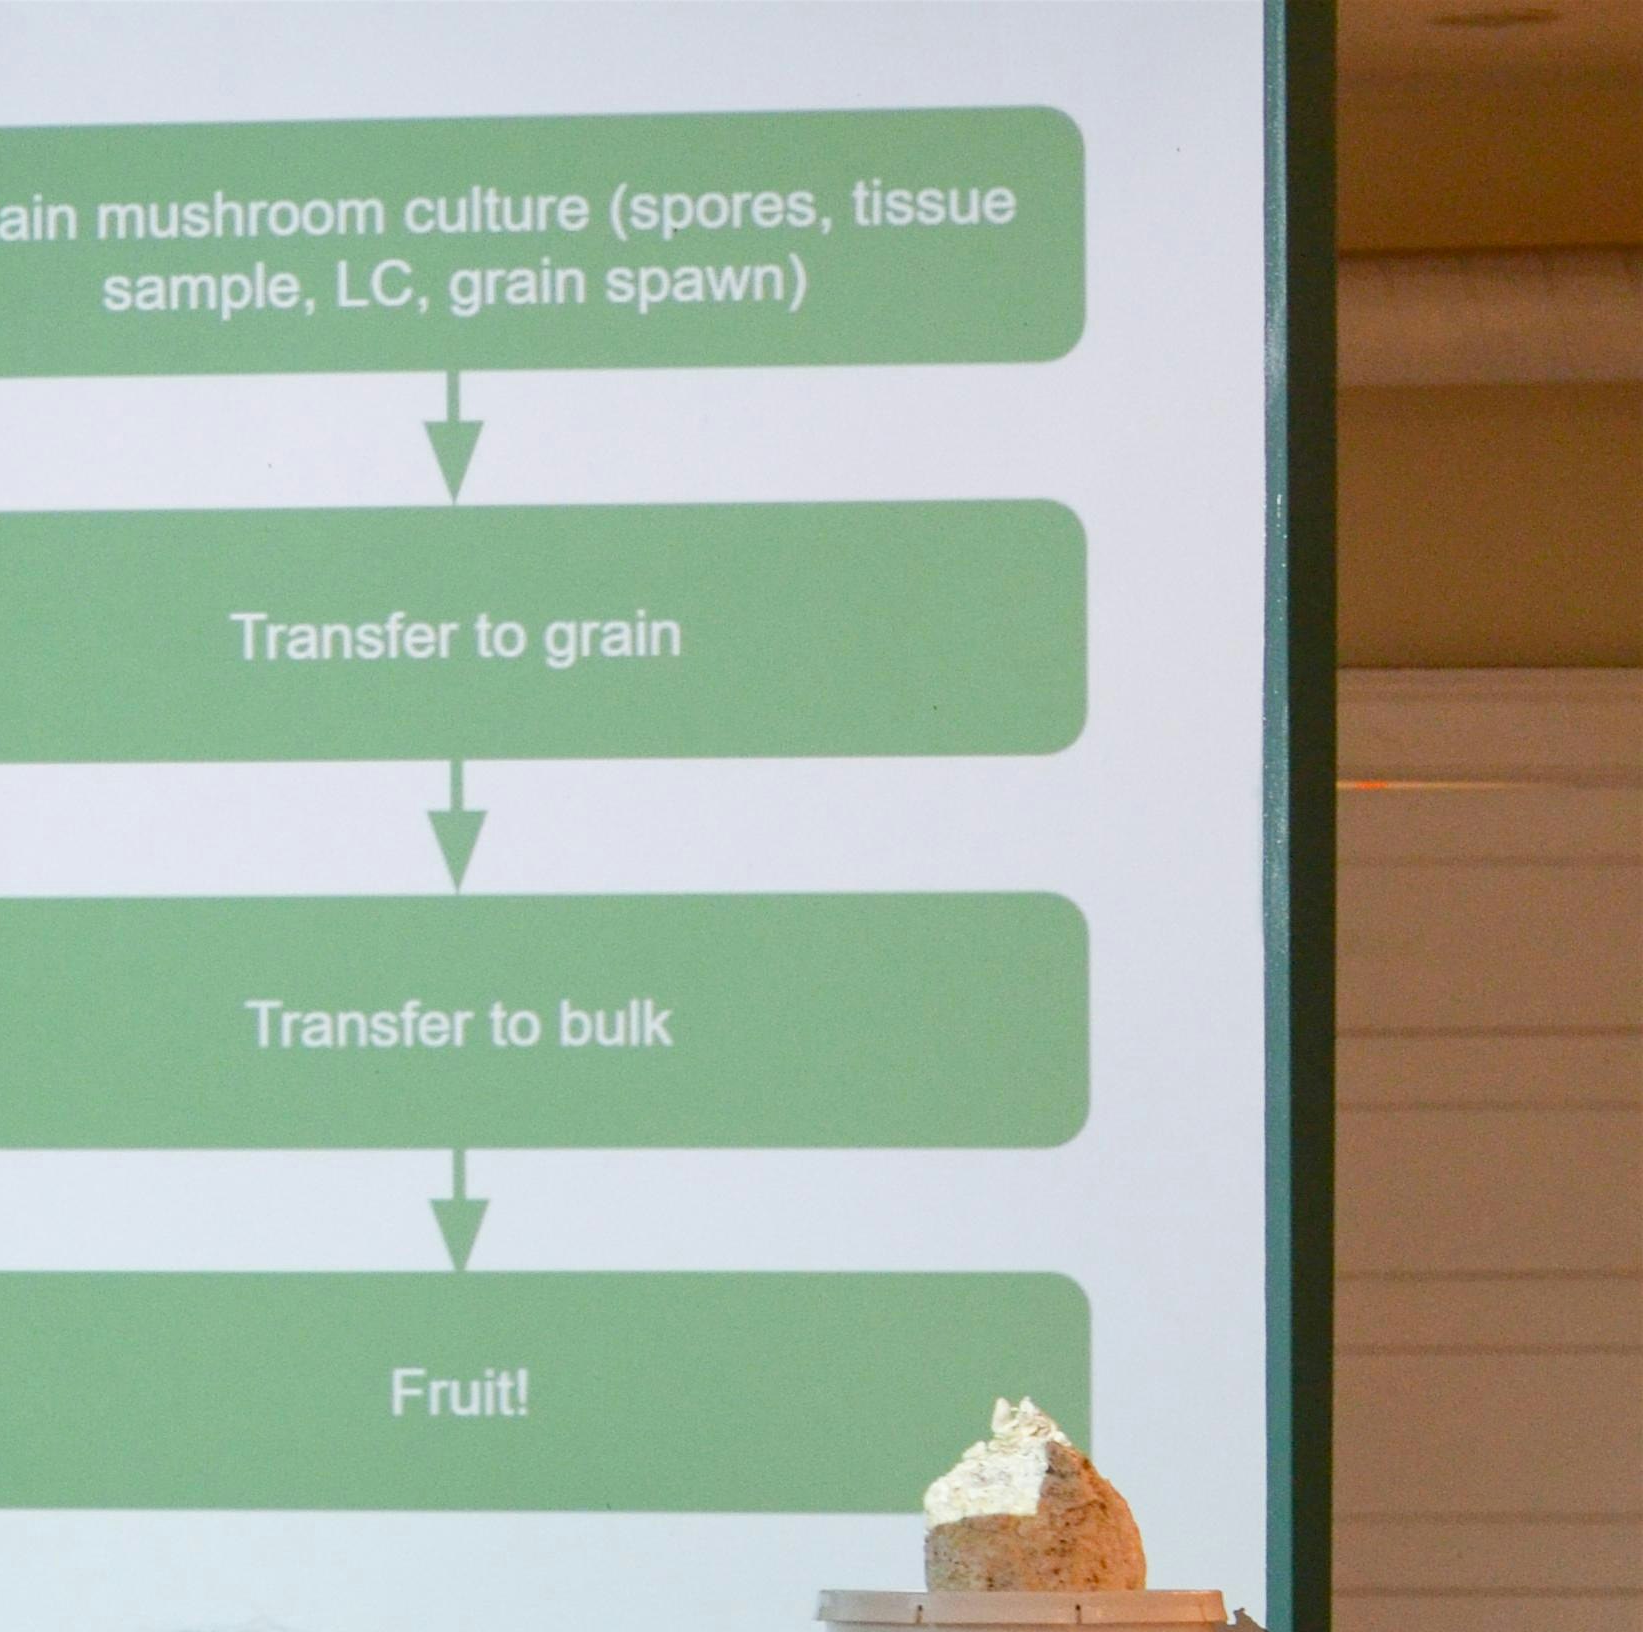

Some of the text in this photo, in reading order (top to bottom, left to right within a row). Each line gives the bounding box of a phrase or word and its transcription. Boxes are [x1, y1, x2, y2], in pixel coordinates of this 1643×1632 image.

[98, 190, 384, 239] mushroom
[404, 185, 589, 233] culture
[610, 183, 831, 241] (spores,
[852, 178, 1016, 226] tissue
[103, 253, 807, 321] sample, LC, grain spawn)
[229, 609, 680, 669] Transfer to grain
[245, 999, 672, 1047] Transfer to bulk
[392, 1368, 528, 1416] Fruit!
